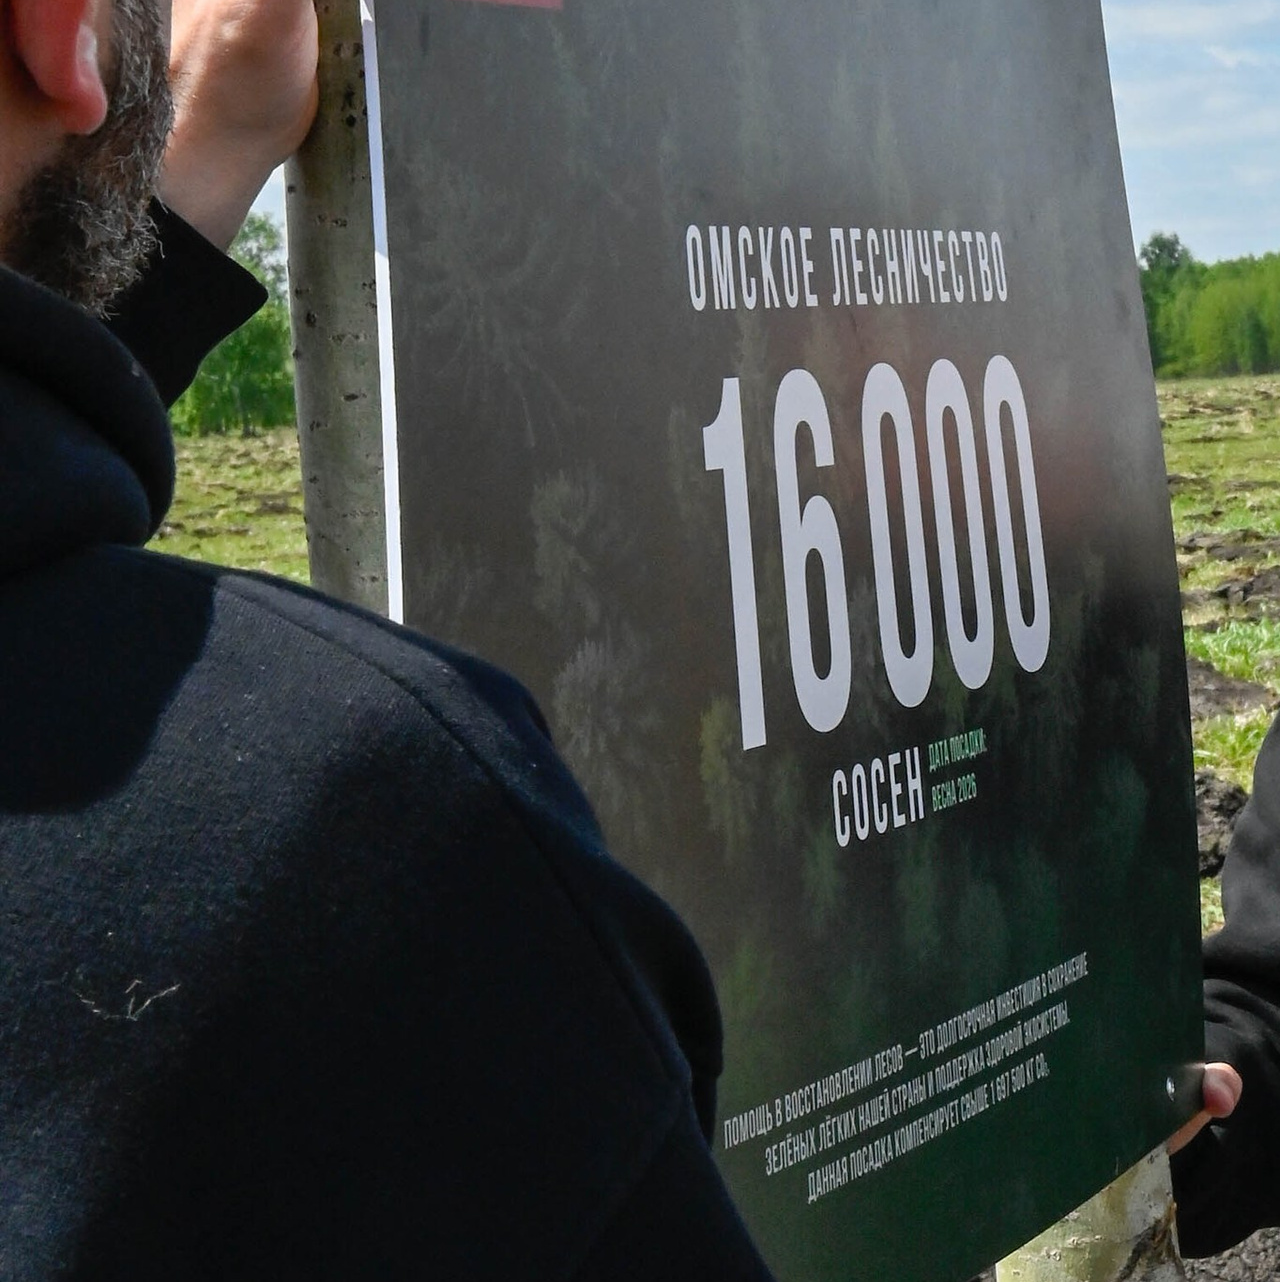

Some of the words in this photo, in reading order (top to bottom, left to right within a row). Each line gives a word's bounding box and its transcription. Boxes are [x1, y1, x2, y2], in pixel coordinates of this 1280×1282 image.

[685, 224, 818, 311] ОМСКОЕ
[829, 227, 1008, 306] ЛЕСНИЧЕСТВО
[832, 746, 926, 848] СОСЕН
[928, 739, 950, 773] ДАТА
[931, 779, 957, 812] ВЕСНА
[957, 772, 978, 803] 2026
[724, 1102, 773, 1149] ПОМОЩЬ
[774, 1098, 783, 1127] В
[784, 1057, 873, 1123] ВОССТАНОВЛЕНИИ
[875, 1043, 904, 1081] ЛЕСОВ
[918, 1029, 936, 1060] ЭТО
[936, 998, 997, 1055] ДОЛГОСРОЧНАЯ
[995, 975, 1042, 1022] ИНВЕСТИЦИЯ
[1042, 972, 1048, 998] В
[765, 1127, 817, 1176] ЗЕЛЁНЫХ
[818, 1107, 858, 1152] ЛЁГКИХ
[857, 1088, 891, 1133] НАШЕЙ
[891, 1073, 927, 1116] СТРАНЫ
[927, 1070, 935, 1098] И
[935, 1045, 986, 1094] ПОДДЕРЖКА
[985, 1020, 1024, 1068] ЗДОРОВОЙ
[807, 1156, 849, 1205] ДАННАЯ
[850, 1133, 894, 1181] ПОСАДКА
[894, 1099, 960, 1158] КОМПЕНСИРУЕТ
[960, 1083, 990, 1122] СВЫШЕ
